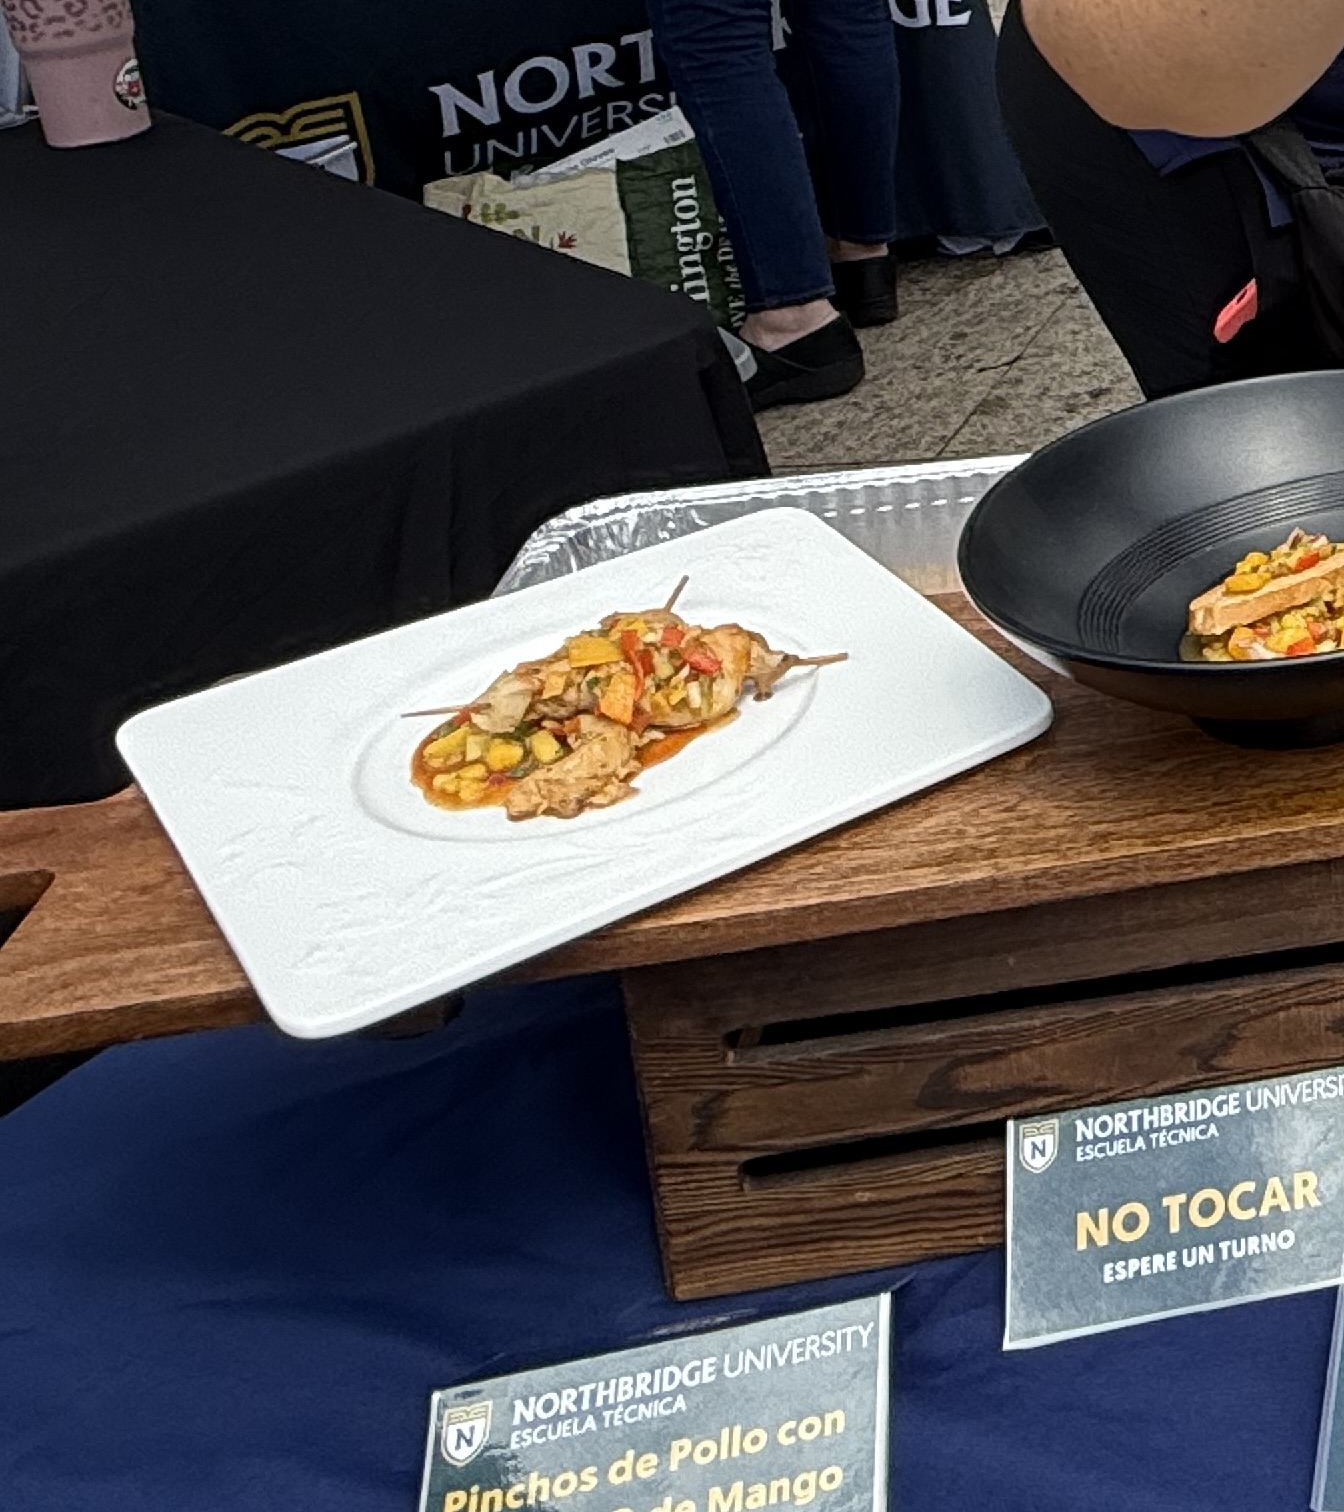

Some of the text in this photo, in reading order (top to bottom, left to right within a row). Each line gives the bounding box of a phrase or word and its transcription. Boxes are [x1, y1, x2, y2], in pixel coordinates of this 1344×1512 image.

[1075, 1092, 1241, 1143] NORTHBRIDGE
[1076, 1123, 1219, 1162] ESCUELA TÉCNICA
[1030, 1139, 1046, 1160] N
[1076, 1170, 1322, 1252] NO TOCAR
[1103, 1229, 1296, 1284] ESPERE UN TURNO
[512, 1321, 875, 1426] NORTHBRIDGE UNIVERSITY
[455, 1426, 475, 1451] N
[510, 1394, 687, 1450] ESCUELA TÉCNICA
[442, 1407, 847, 1512] Pinchos de Pollo con
[707, 1464, 845, 1512] Mango
